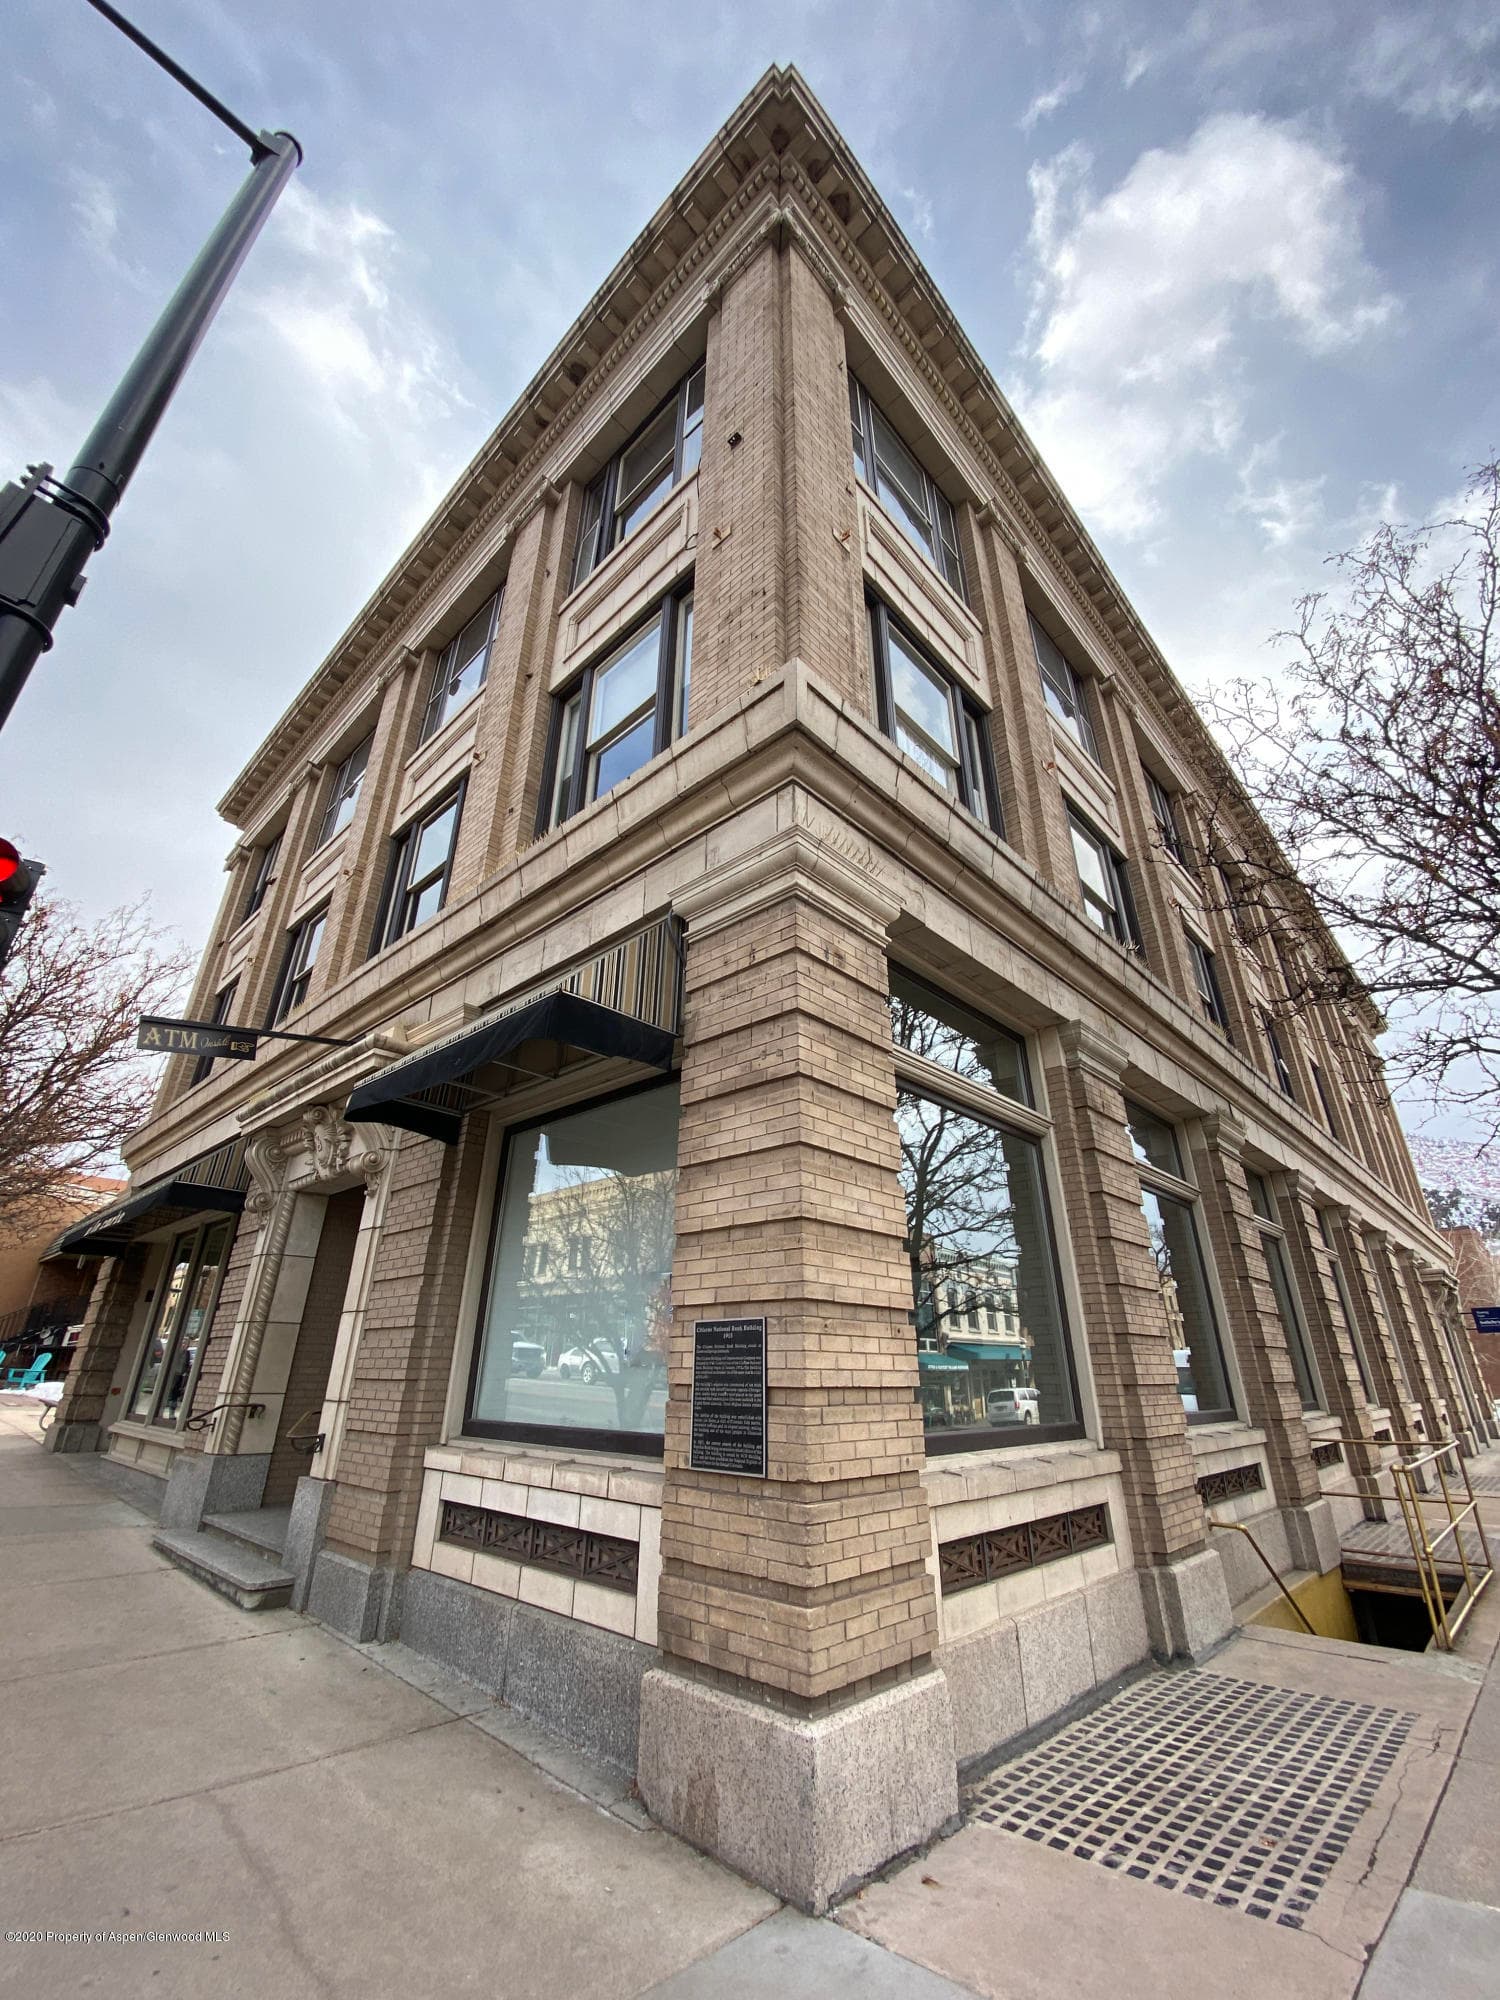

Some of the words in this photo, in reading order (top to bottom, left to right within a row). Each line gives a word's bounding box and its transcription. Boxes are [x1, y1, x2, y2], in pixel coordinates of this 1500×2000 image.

[143, 1027, 199, 1049] ATM
[200, 1034, 231, 1049] Inside
[743, 1324, 762, 1332] Building
